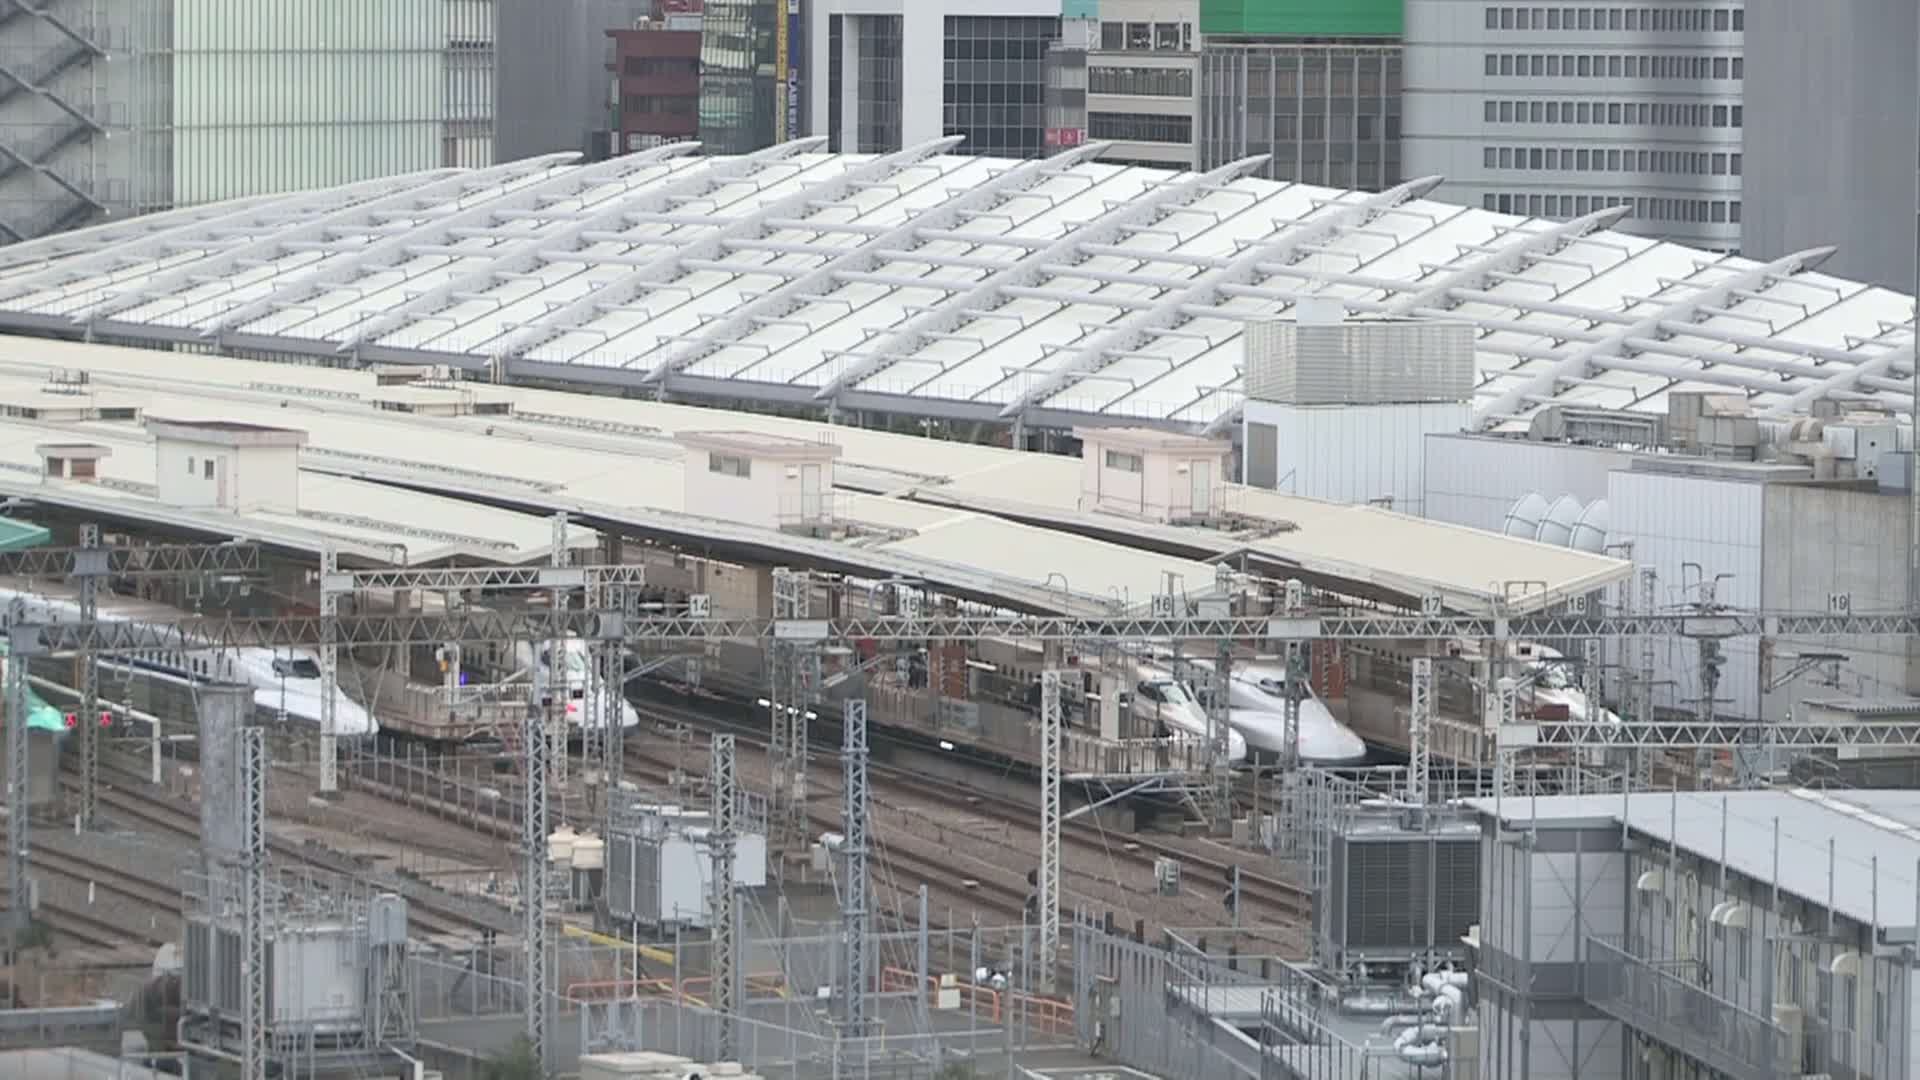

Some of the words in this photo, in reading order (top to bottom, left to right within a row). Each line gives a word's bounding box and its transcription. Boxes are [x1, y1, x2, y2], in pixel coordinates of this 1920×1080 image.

[692, 598, 709, 612] 14
[902, 597, 918, 612] 15
[1155, 597, 1171, 612] 16
[1425, 597, 1440, 611] 17
[1569, 597, 1585, 611] 18
[1832, 595, 1847, 611] 19
